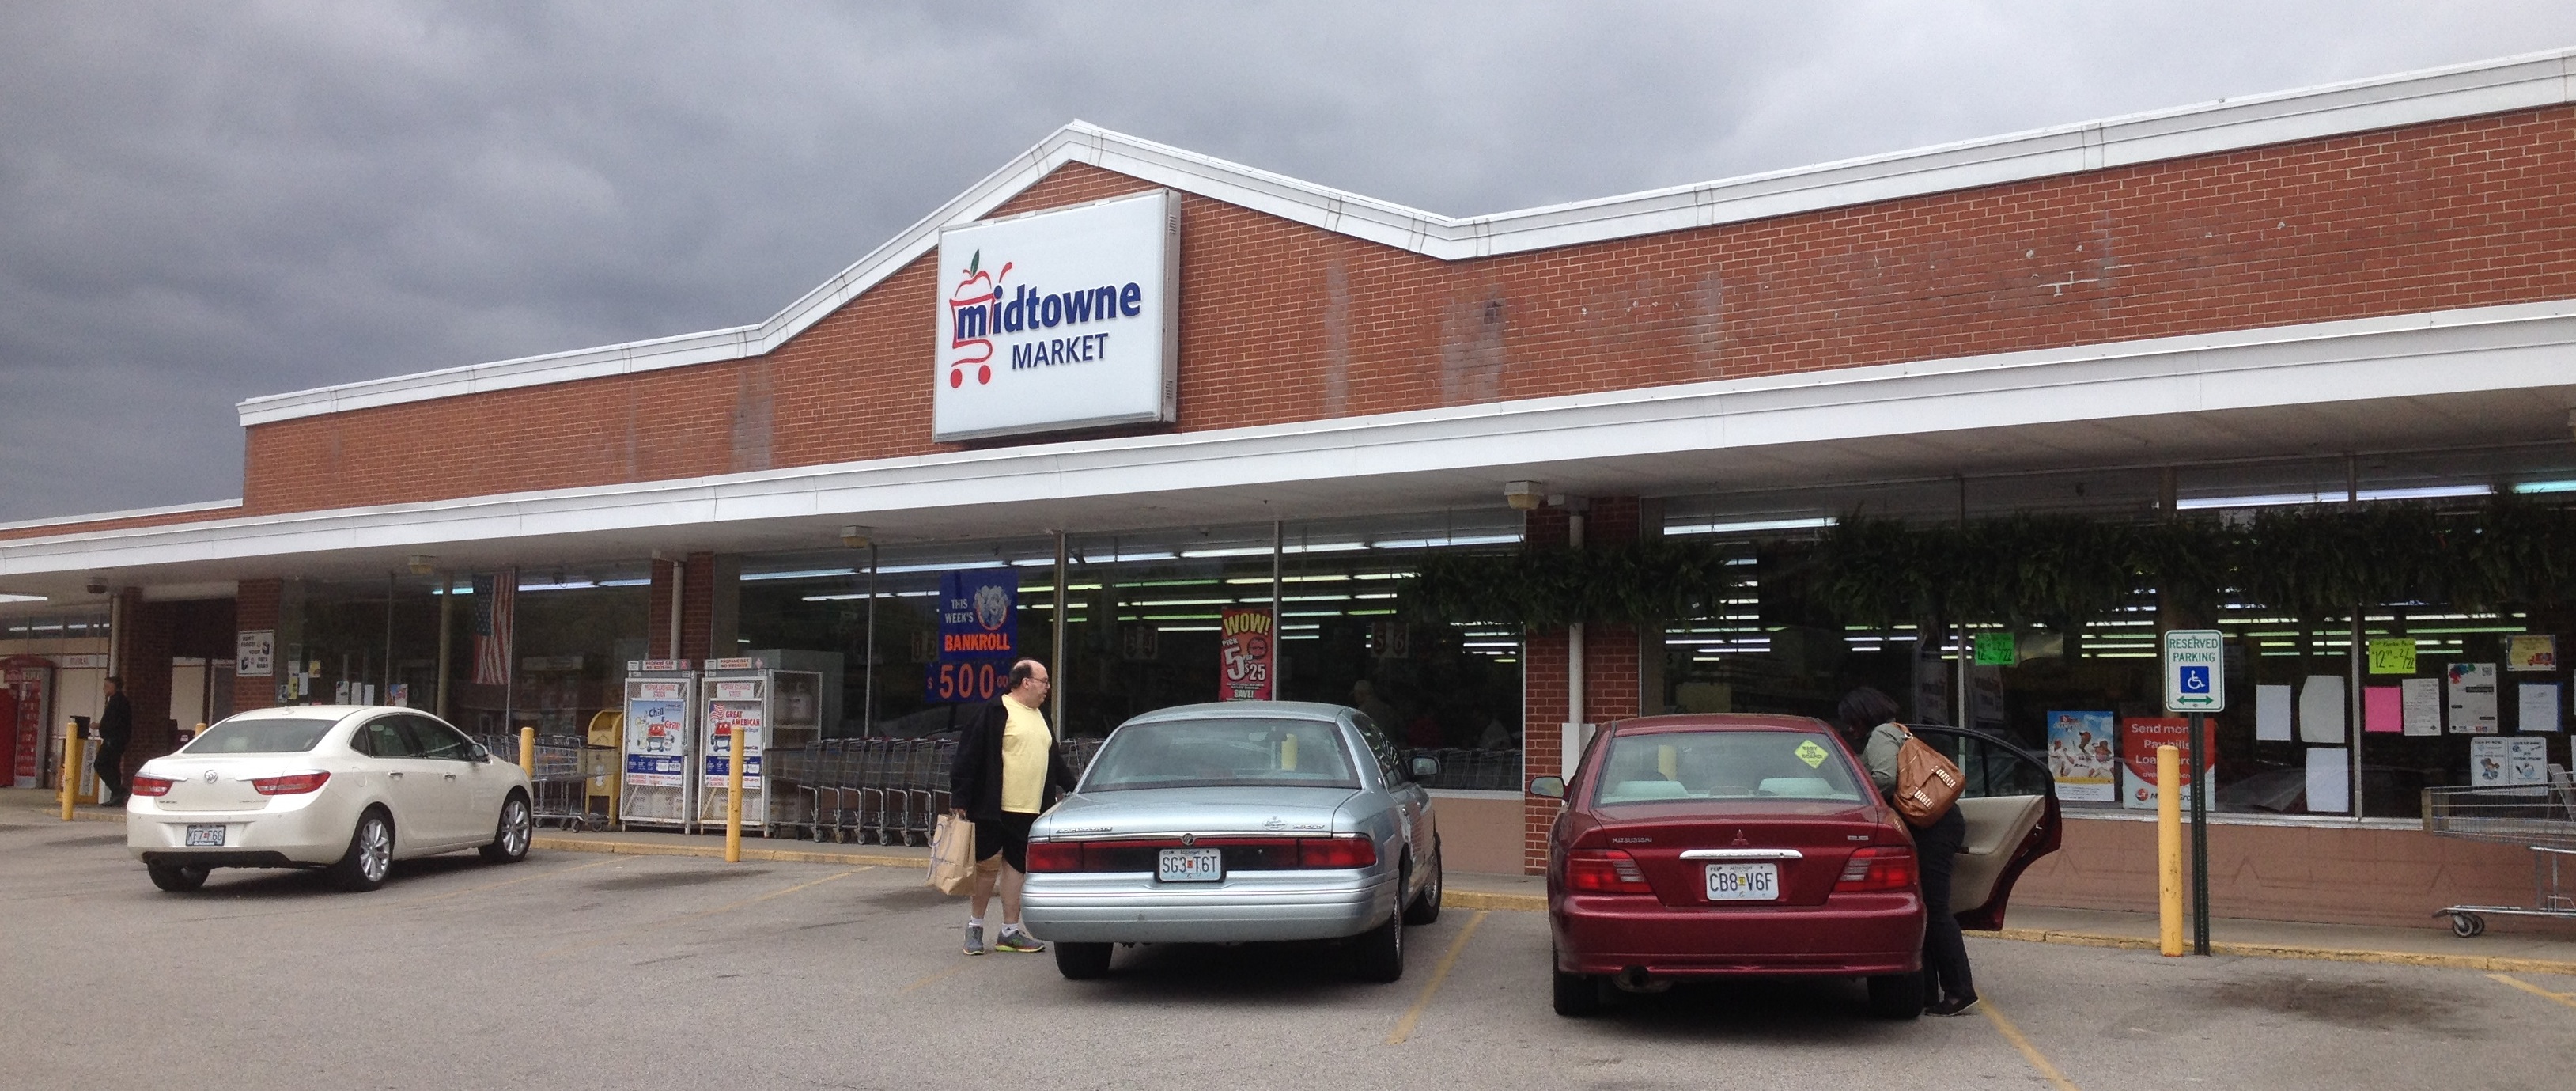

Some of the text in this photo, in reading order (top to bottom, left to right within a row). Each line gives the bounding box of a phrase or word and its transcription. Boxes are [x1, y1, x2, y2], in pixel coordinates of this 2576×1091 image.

[957, 282, 1141, 339] midtowne
[1012, 332, 1109, 370] MARKET
[951, 599, 967, 609] THIS
[945, 612, 974, 623] WEEK'S
[1224, 613, 1271, 636] WOW!
[944, 633, 1011, 652] BANKROLL
[2169, 638, 2219, 649] RESERVED
[2173, 652, 2215, 662] PARKING
[1224, 646, 1245, 680] 5
[940, 663, 994, 699] 500
[1234, 689, 1254, 698] SAVE!
[649, 707, 664, 718] Chill
[664, 720, 680, 731] Grill
[2132, 723, 2161, 733] Send
[2135, 755, 2157, 764] Loa
[1163, 855, 1217, 873] SG3 T6T
[1709, 872, 1773, 892] CB8 V6F
